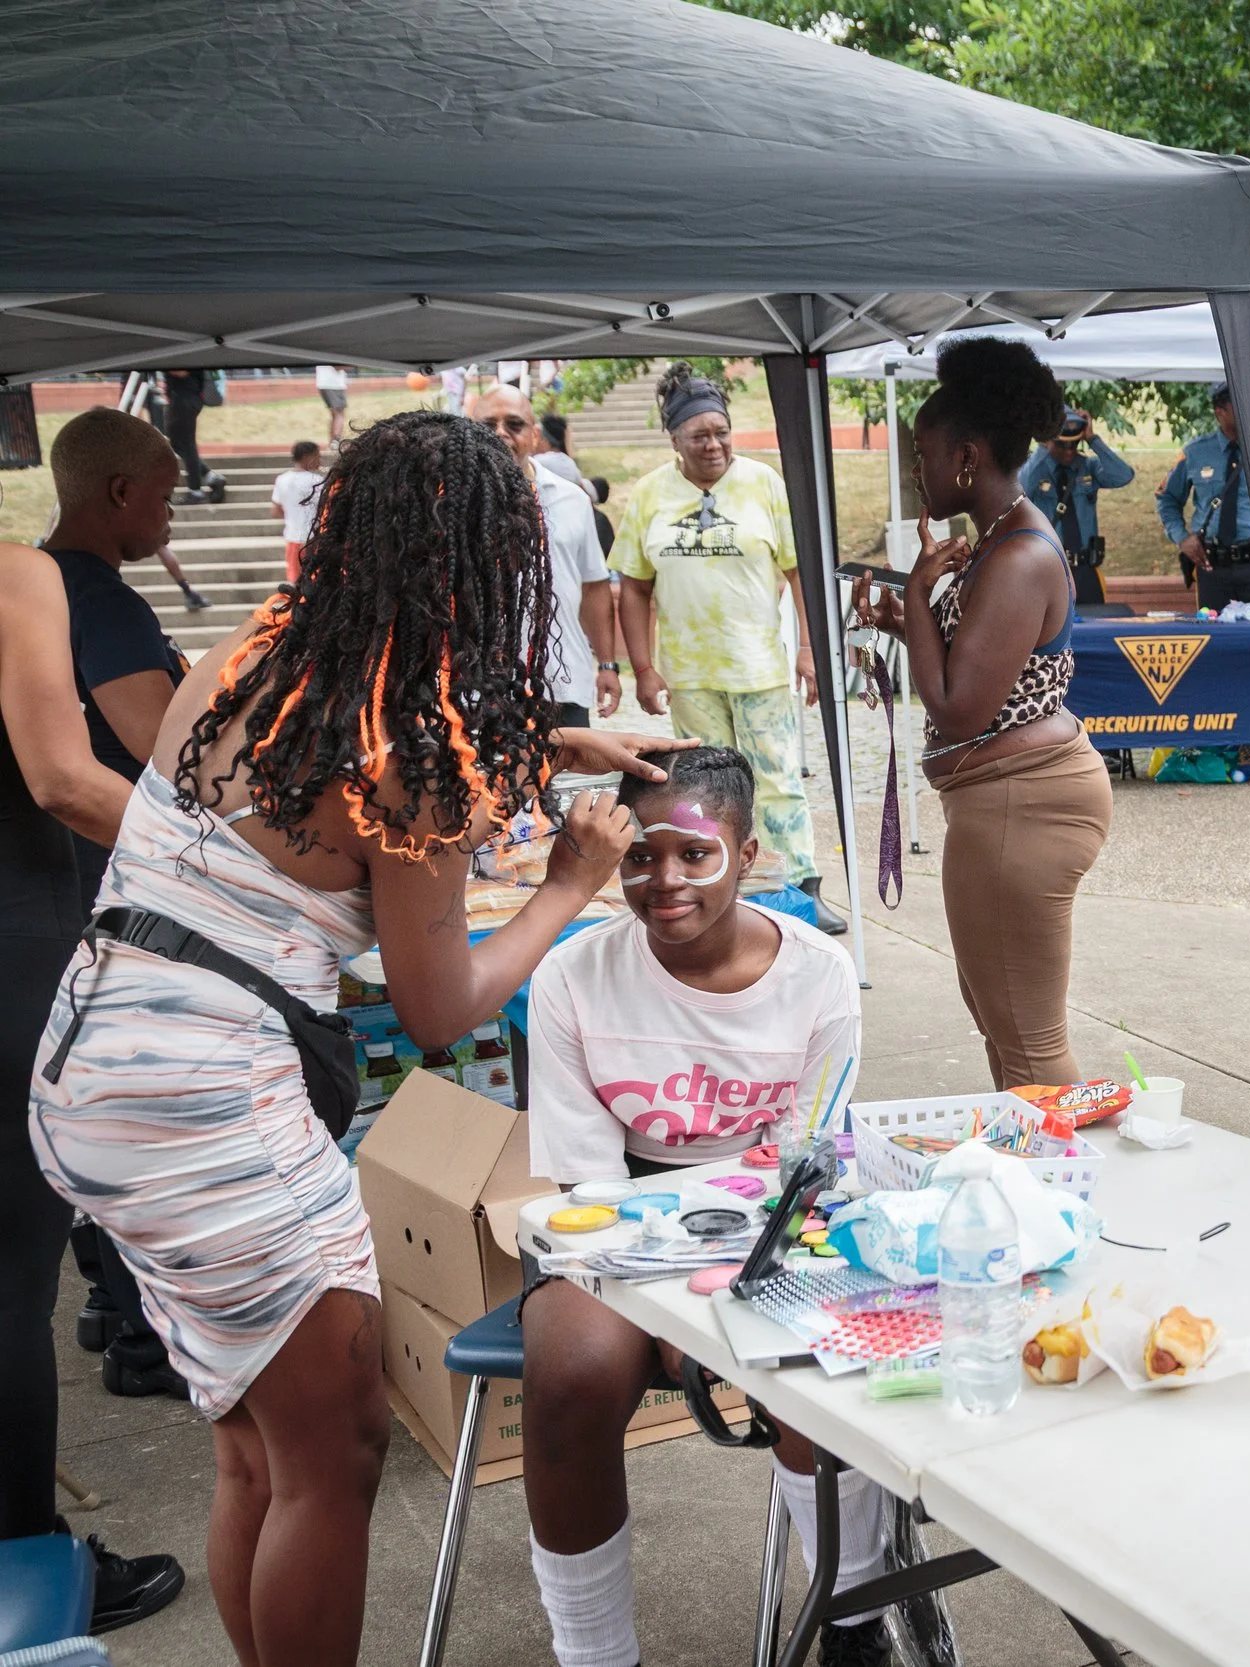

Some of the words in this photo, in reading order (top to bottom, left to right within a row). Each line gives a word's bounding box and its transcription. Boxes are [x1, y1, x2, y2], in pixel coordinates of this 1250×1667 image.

[690, 548, 713, 556] ALLEN
[718, 547, 739, 555] PARK
[1136, 643, 1189, 656] STATE
[1142, 656, 1182, 664] POLICE
[1148, 665, 1175, 684] NJ
[1083, 714, 1190, 734] RECRUITING
[1193, 713, 1238, 731] UNIT
[662, 1063, 798, 1107] cherr
[348, 1122, 373, 1135] DISPO
[503, 1393, 523, 1407] BA
